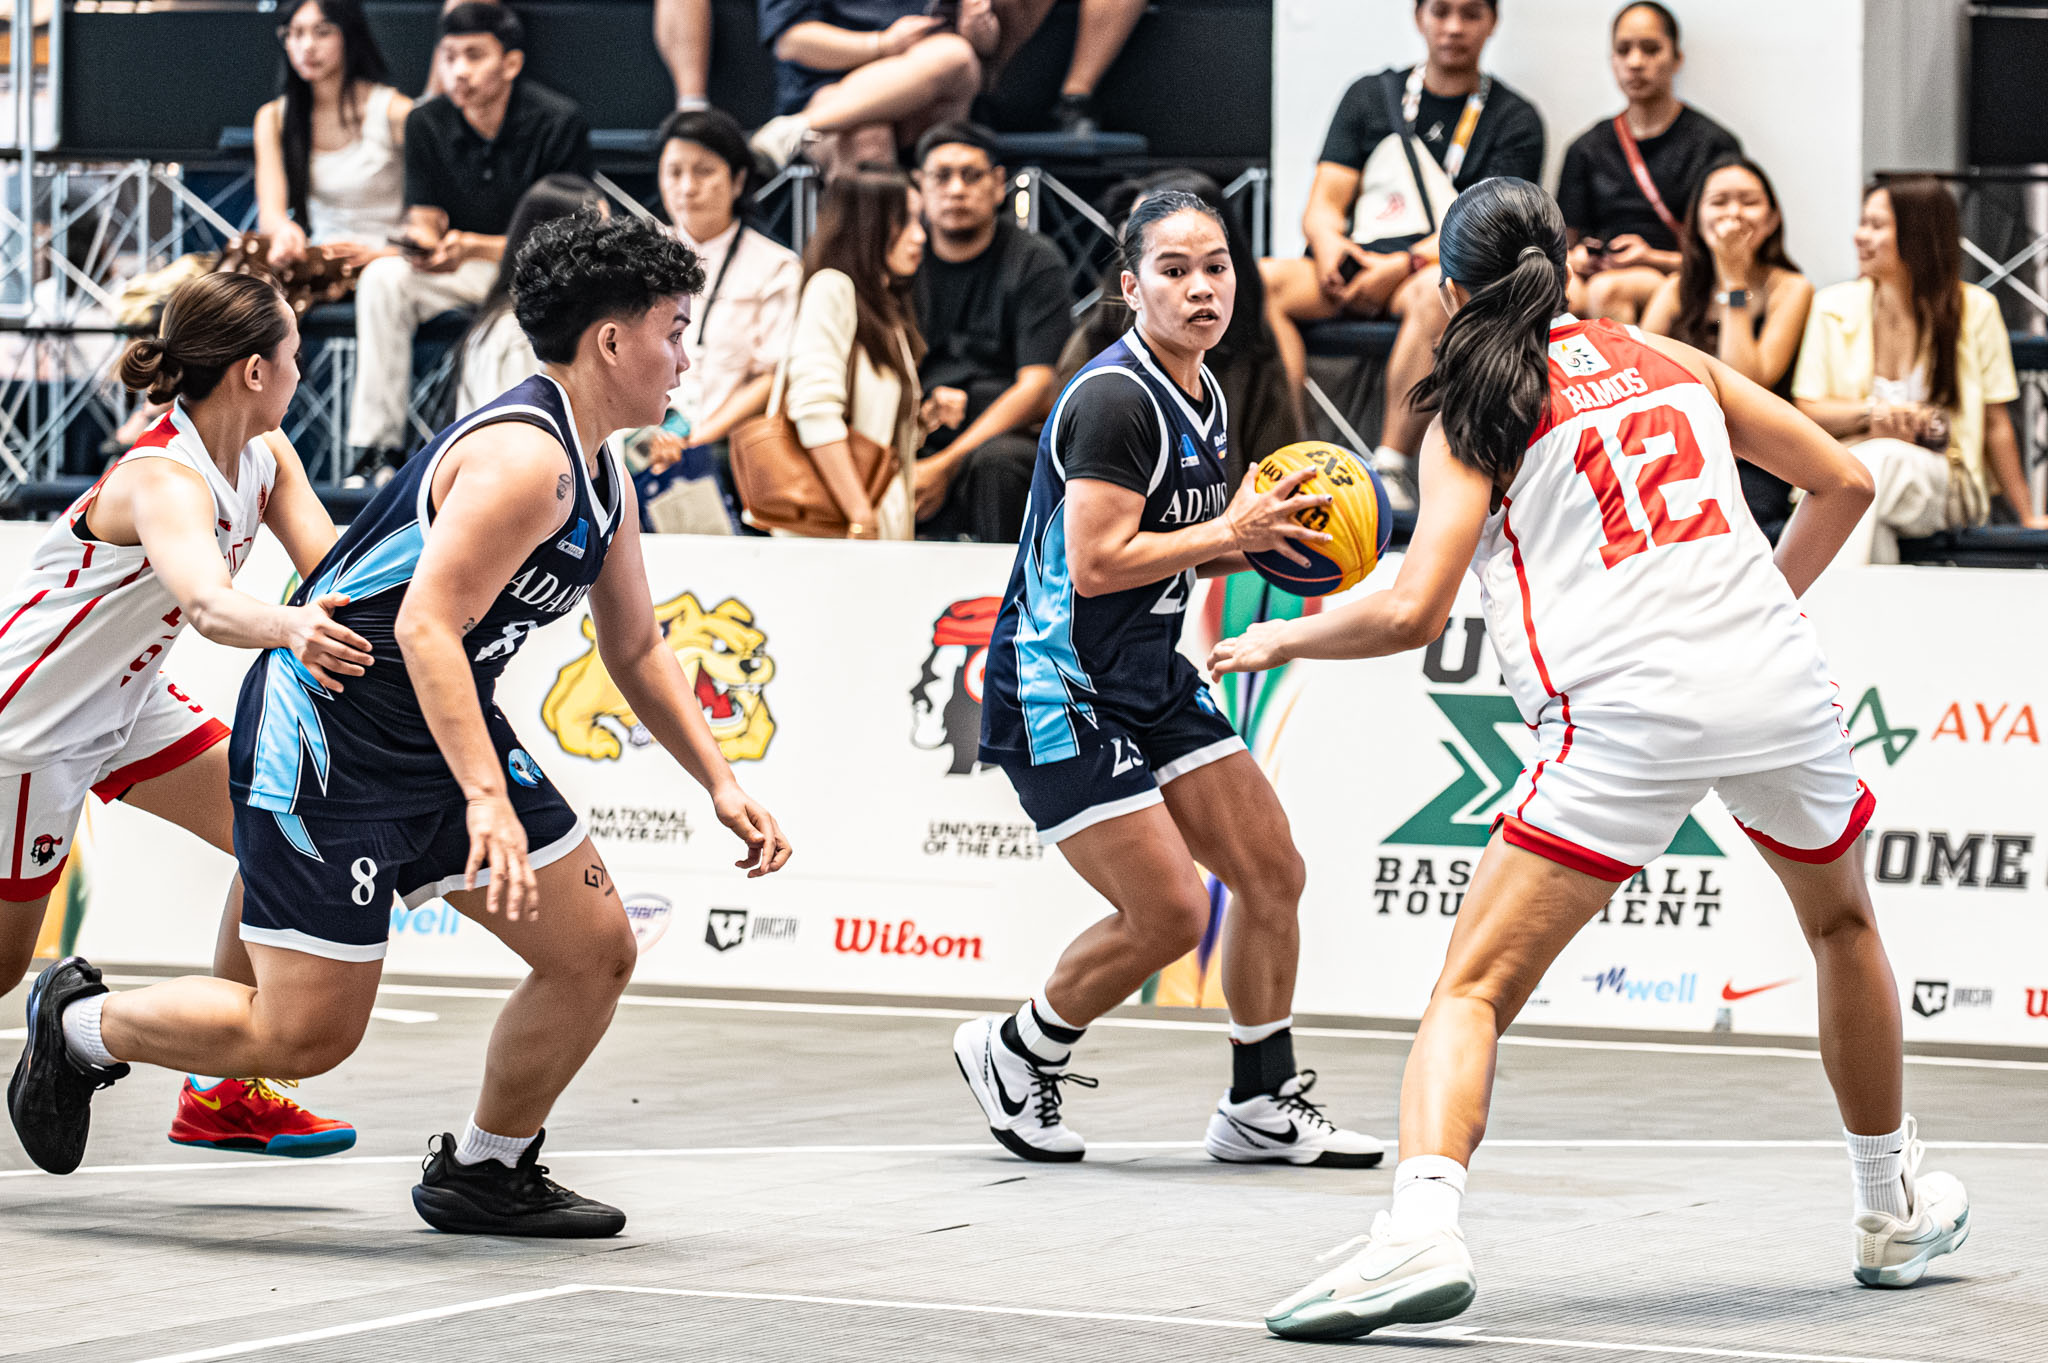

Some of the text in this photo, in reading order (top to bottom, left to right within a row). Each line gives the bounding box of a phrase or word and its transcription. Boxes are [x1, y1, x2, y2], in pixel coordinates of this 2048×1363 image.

[1562, 367, 1648, 413] RAMOS
[1574, 404, 1731, 570] 12
[590, 807, 687, 828] NATIONAL
[929, 820, 1036, 838] UNIVERSIT
[1374, 857, 1721, 898] BASALL
[1863, 830, 2035, 889] OME
[350, 856, 379, 906] 8
[390, 902, 459, 935] well
[1373, 889, 1721, 926] TOUENT
[834, 916, 983, 960] Wilson
